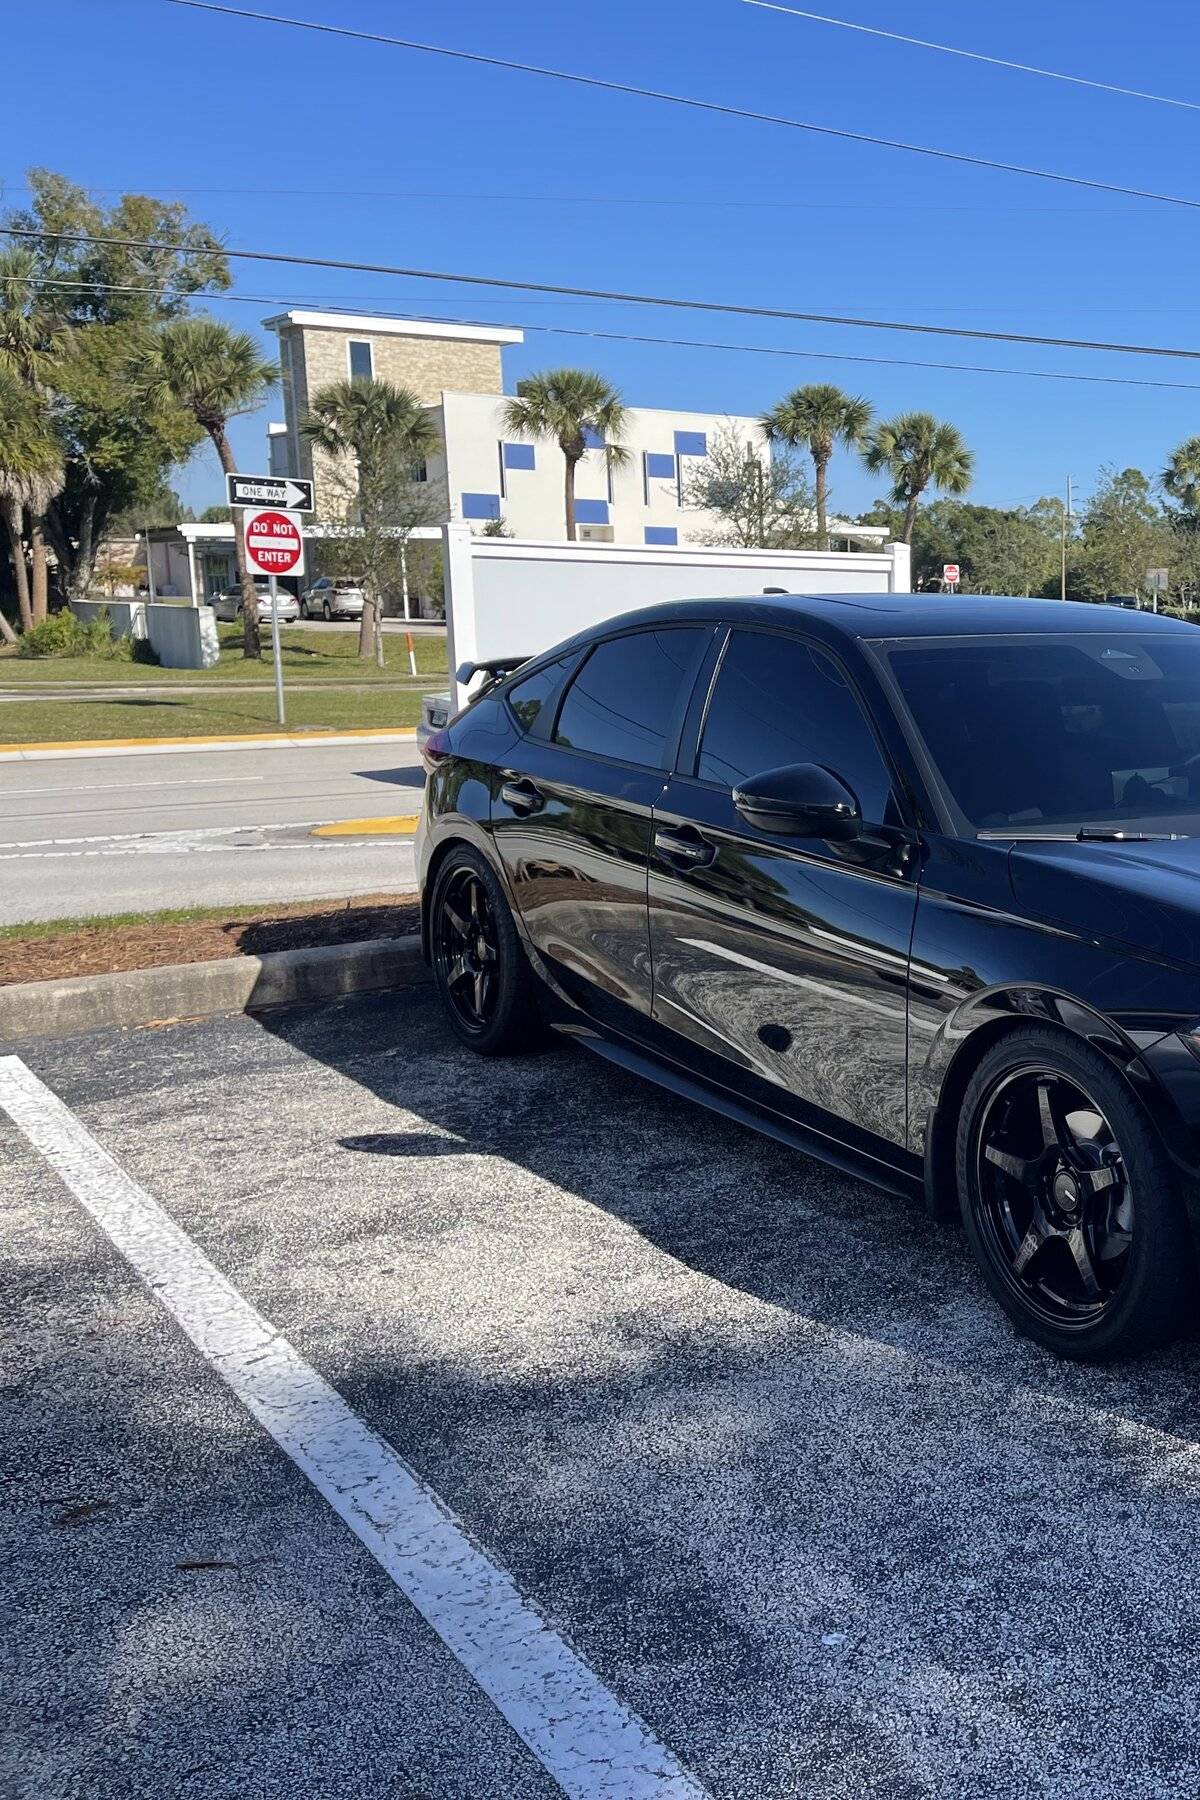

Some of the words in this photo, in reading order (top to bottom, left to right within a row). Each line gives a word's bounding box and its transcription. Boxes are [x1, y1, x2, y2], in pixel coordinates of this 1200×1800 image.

[242, 486, 262, 497] ONE
[266, 489, 286, 498] WAY
[253, 522, 268, 533] DO
[273, 524, 293, 535] NOT
[258, 551, 291, 563] ENTER
